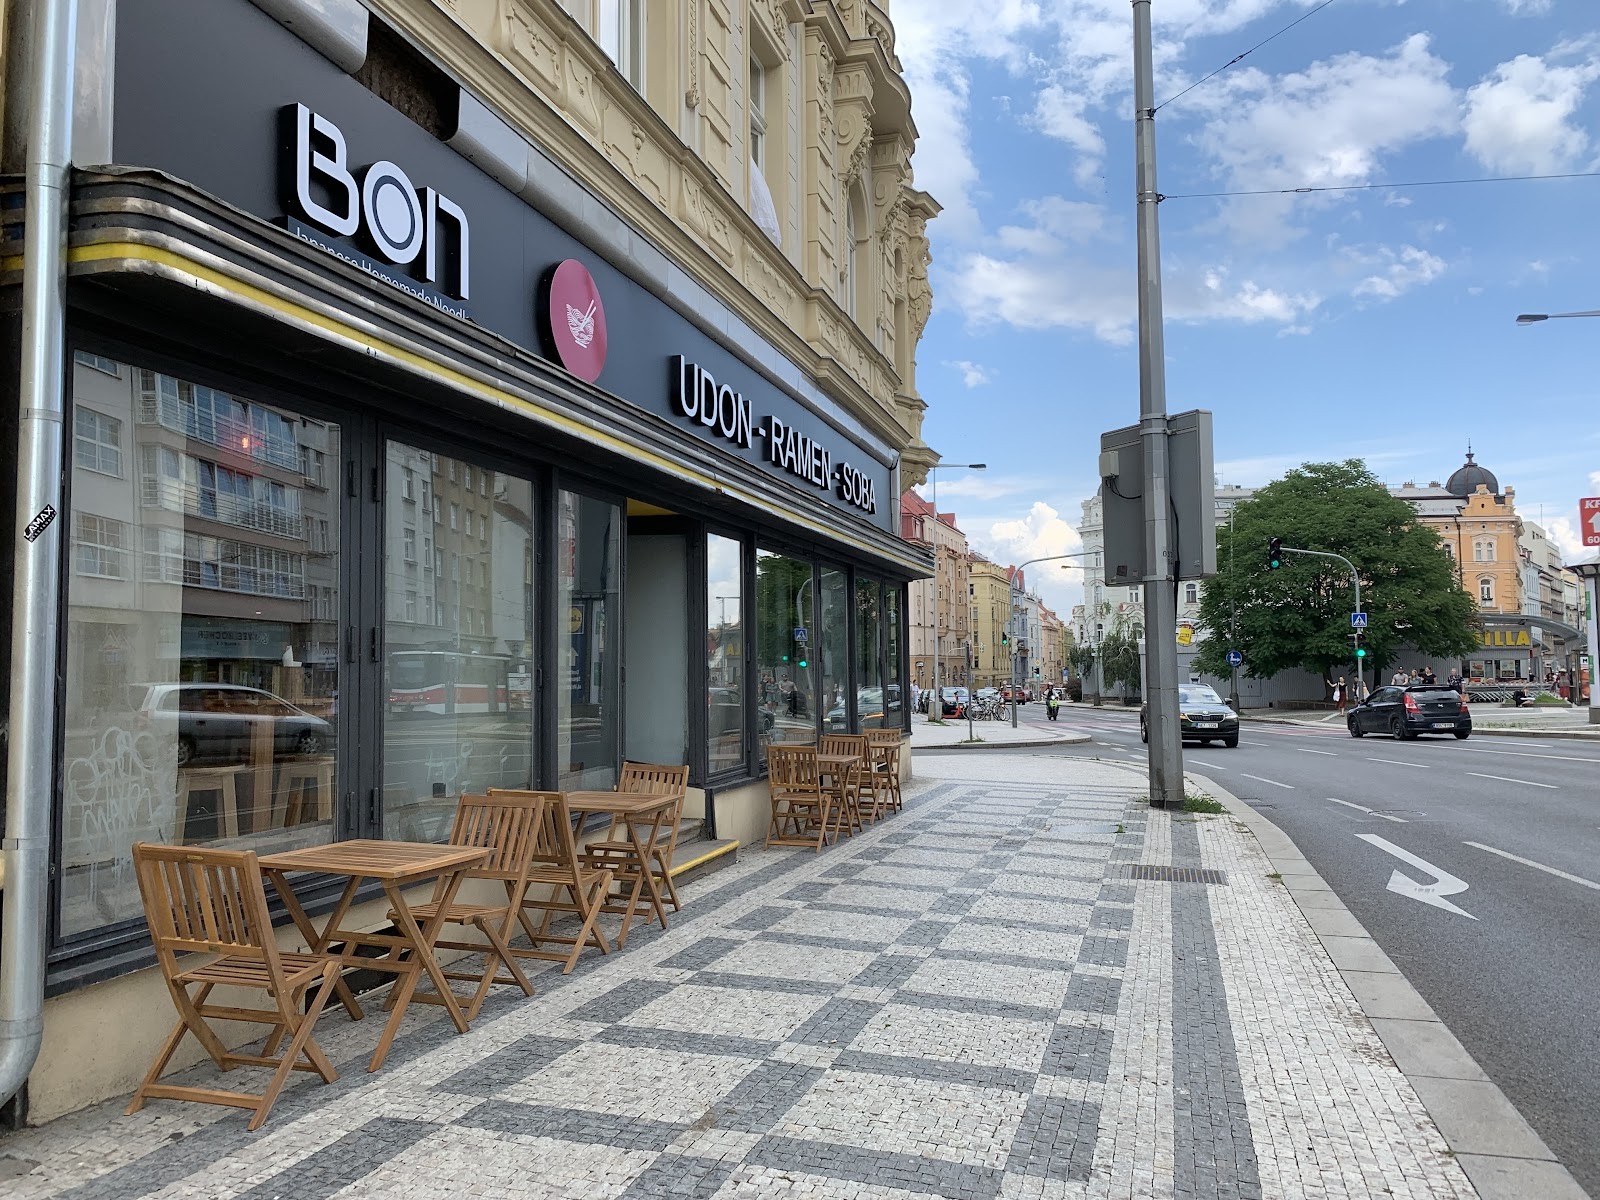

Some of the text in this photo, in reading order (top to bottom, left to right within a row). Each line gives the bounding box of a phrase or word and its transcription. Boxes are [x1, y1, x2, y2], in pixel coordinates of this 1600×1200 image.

[434, 296, 469, 319] Noodl
[681, 354, 752, 449] UDON
[772, 415, 831, 490] RAMEN
[843, 462, 877, 514] SOBA
[24, 506, 54, 539] LAMAX
